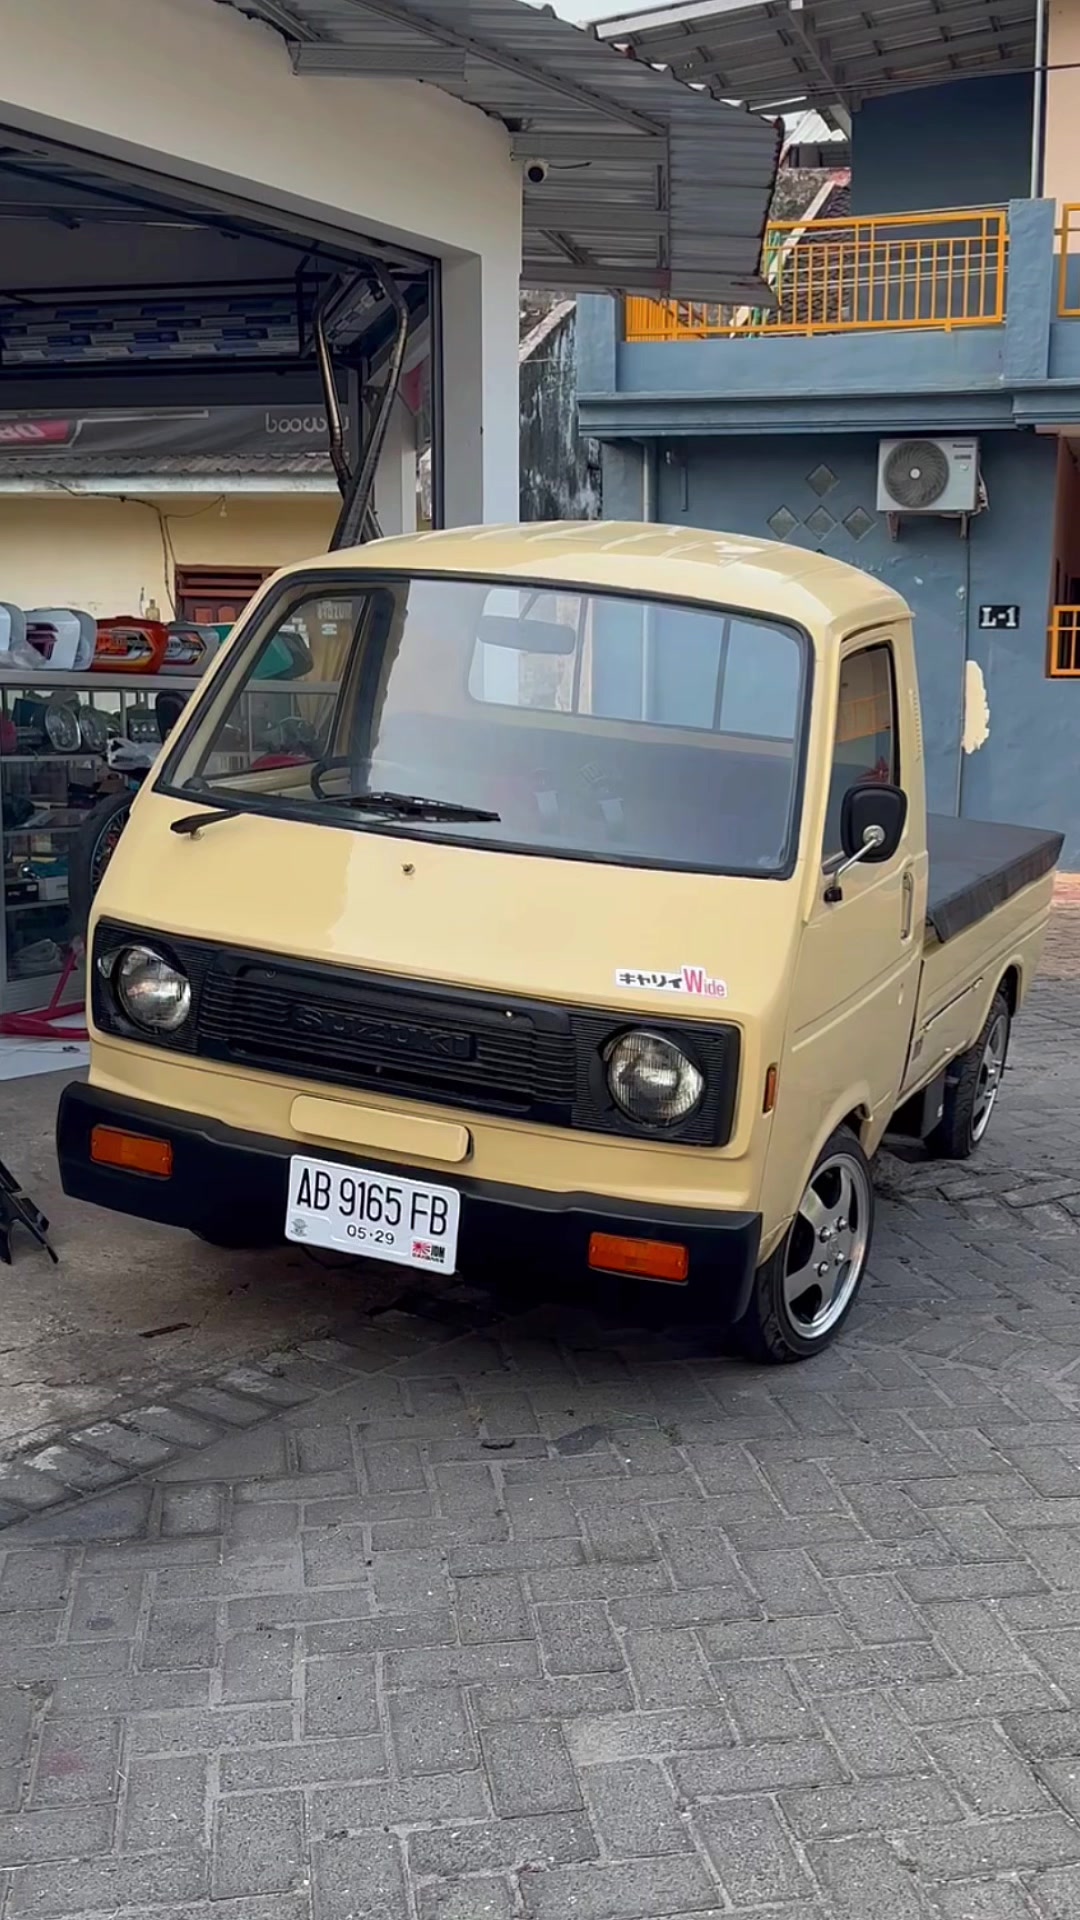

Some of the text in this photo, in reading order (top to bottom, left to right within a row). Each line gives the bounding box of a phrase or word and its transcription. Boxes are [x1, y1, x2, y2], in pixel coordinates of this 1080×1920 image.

[981, 606, 1017, 627] L-1
[683, 968, 725, 997] Wide
[295, 1005, 471, 1058] SUZUKI
[296, 1167, 449, 1236] AB 9165 FB
